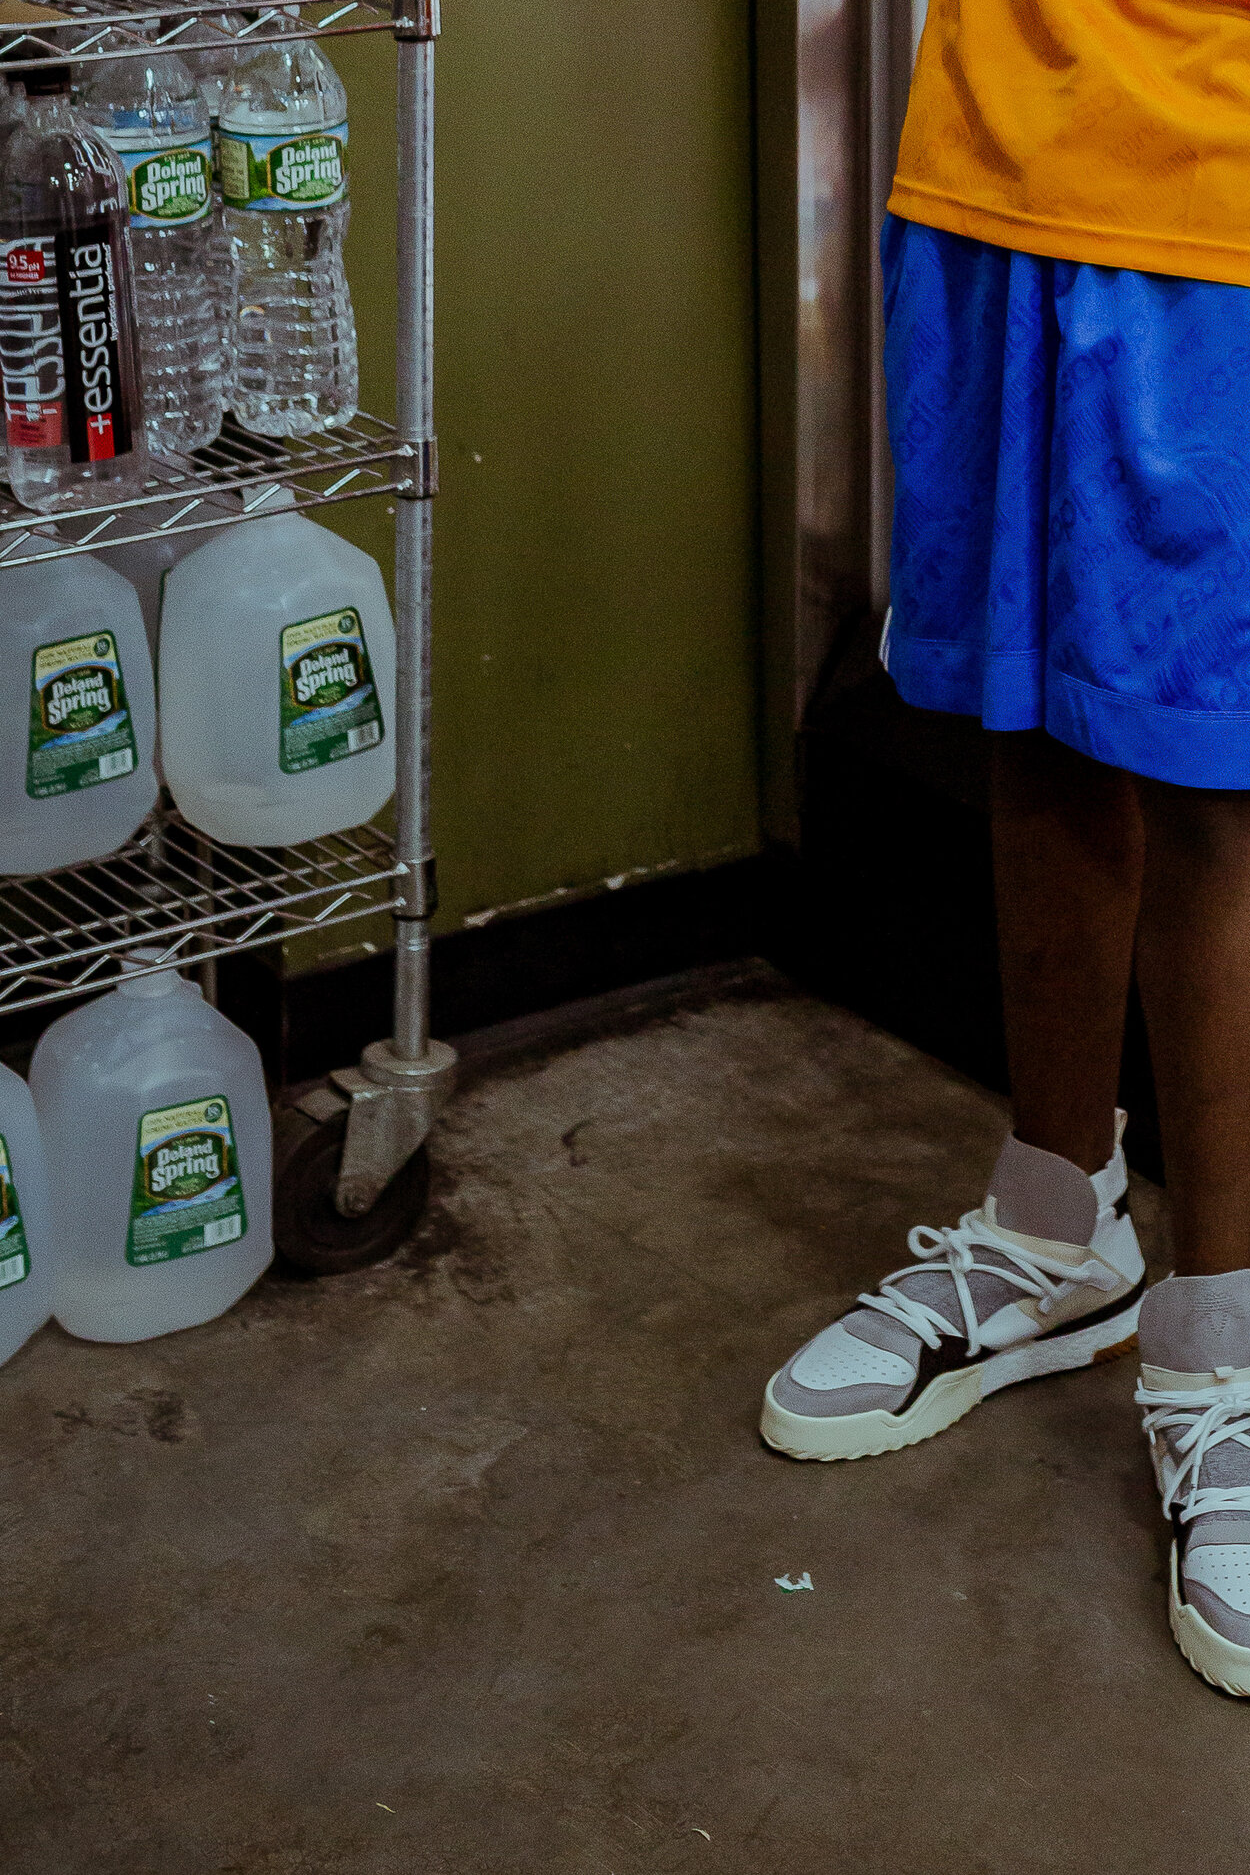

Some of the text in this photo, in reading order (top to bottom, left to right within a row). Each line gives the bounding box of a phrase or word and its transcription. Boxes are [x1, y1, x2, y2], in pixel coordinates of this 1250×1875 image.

[147, 156, 201, 183] Poland
[281, 140, 337, 167] Poland
[141, 175, 207, 212] Spring
[275, 158, 343, 195] Spring
[69, 242, 113, 414] essentia
[300, 648, 350, 675] Poland
[52, 673, 104, 701] Poland
[296, 663, 359, 702] Spring
[48, 687, 112, 725] Spring
[157, 1139, 213, 1166] Poland
[151, 1154, 221, 1192] Spring
